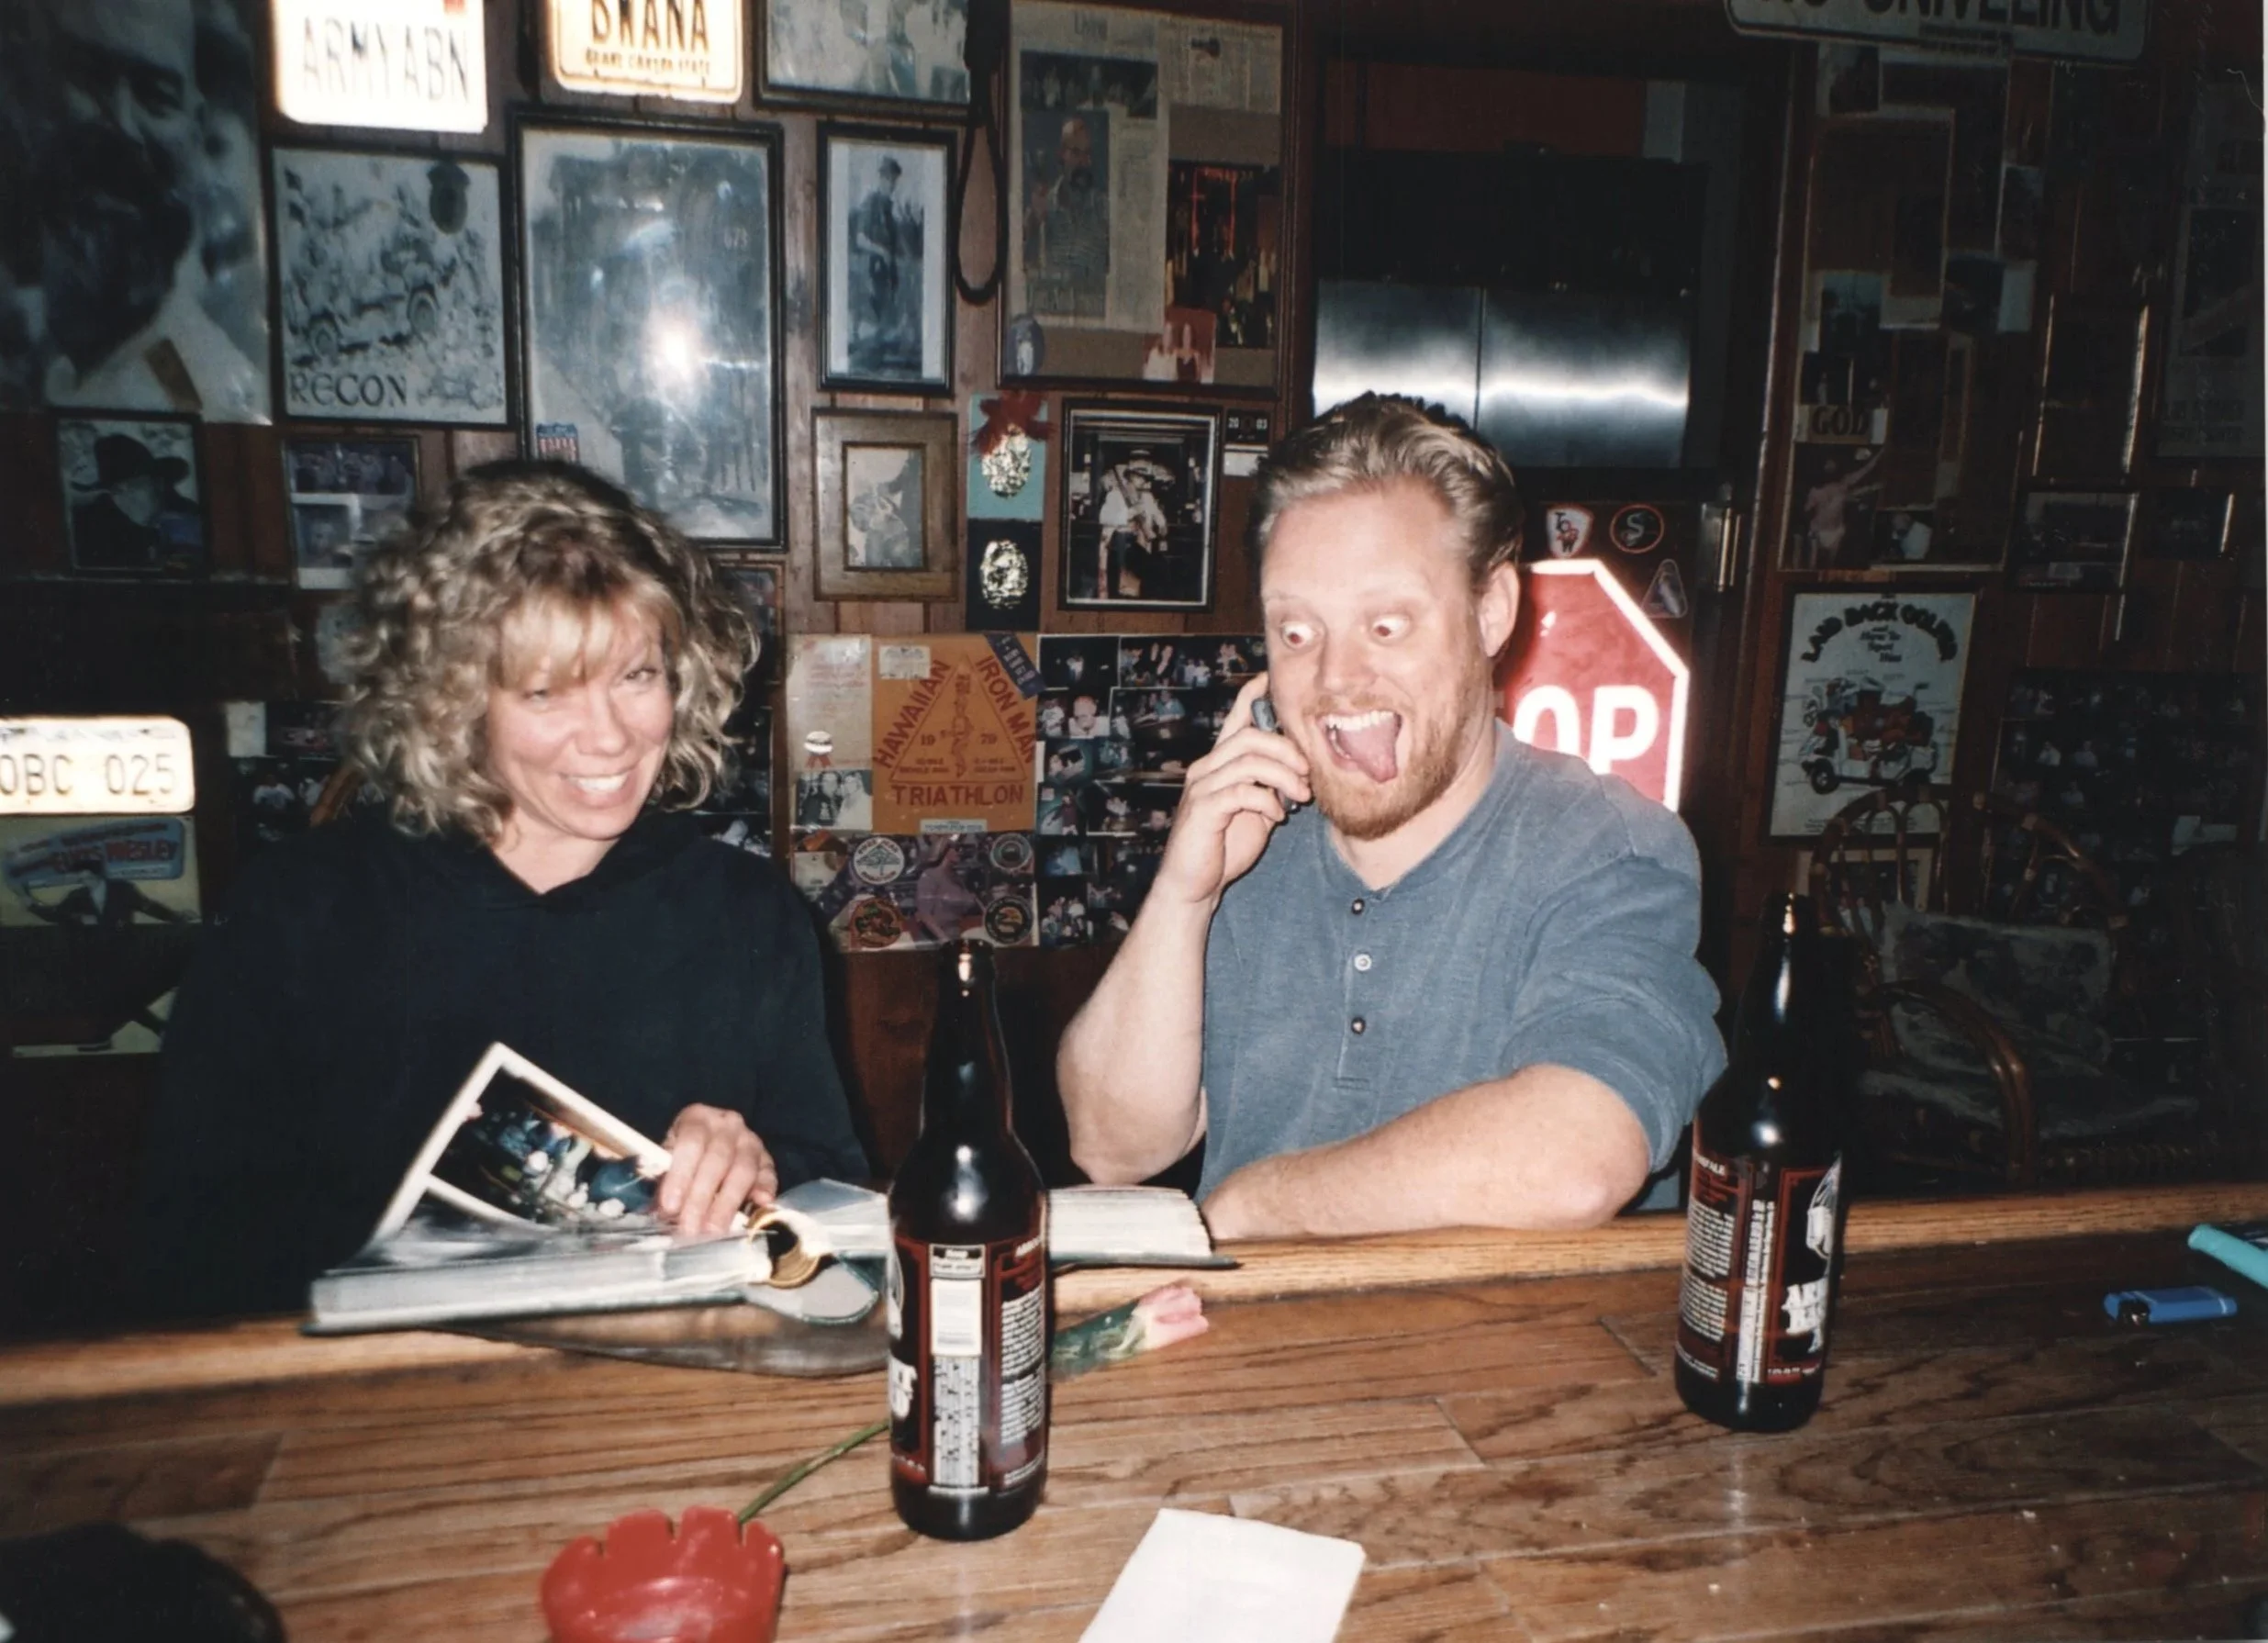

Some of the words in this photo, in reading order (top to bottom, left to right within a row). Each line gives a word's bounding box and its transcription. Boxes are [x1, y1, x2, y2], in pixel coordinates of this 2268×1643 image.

[1844, 601, 1899, 627] BACK
[974, 654, 1020, 712] IRON
[873, 658, 952, 769] HAWAIIAN
[1512, 683, 1660, 775] OP
[104, 753, 177, 796] 025
[890, 783, 1024, 807] TRIATHLON
